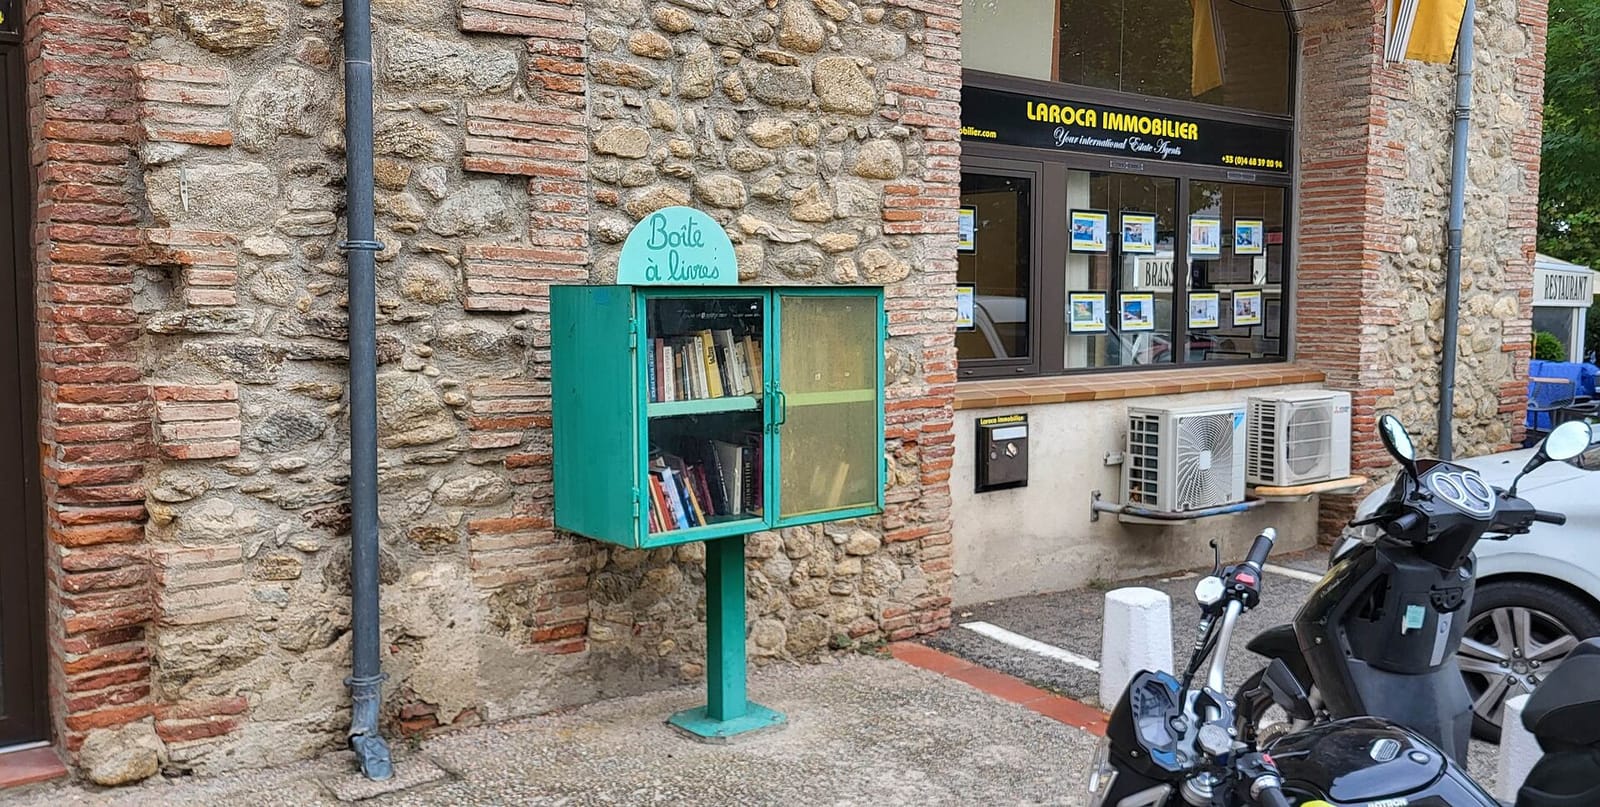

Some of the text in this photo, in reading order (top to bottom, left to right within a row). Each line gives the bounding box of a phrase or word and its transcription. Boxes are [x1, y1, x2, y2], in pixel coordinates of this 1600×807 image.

[1027, 102, 1198, 141] LAROCA IMMOBILIER
[1053, 126, 1182, 160] Your international Estate Agents
[1222, 155, 1234, 164] +33
[646, 213, 705, 251] Boîte
[645, 249, 720, 282] à livres
[1544, 274, 1588, 301] RESTAURANT
